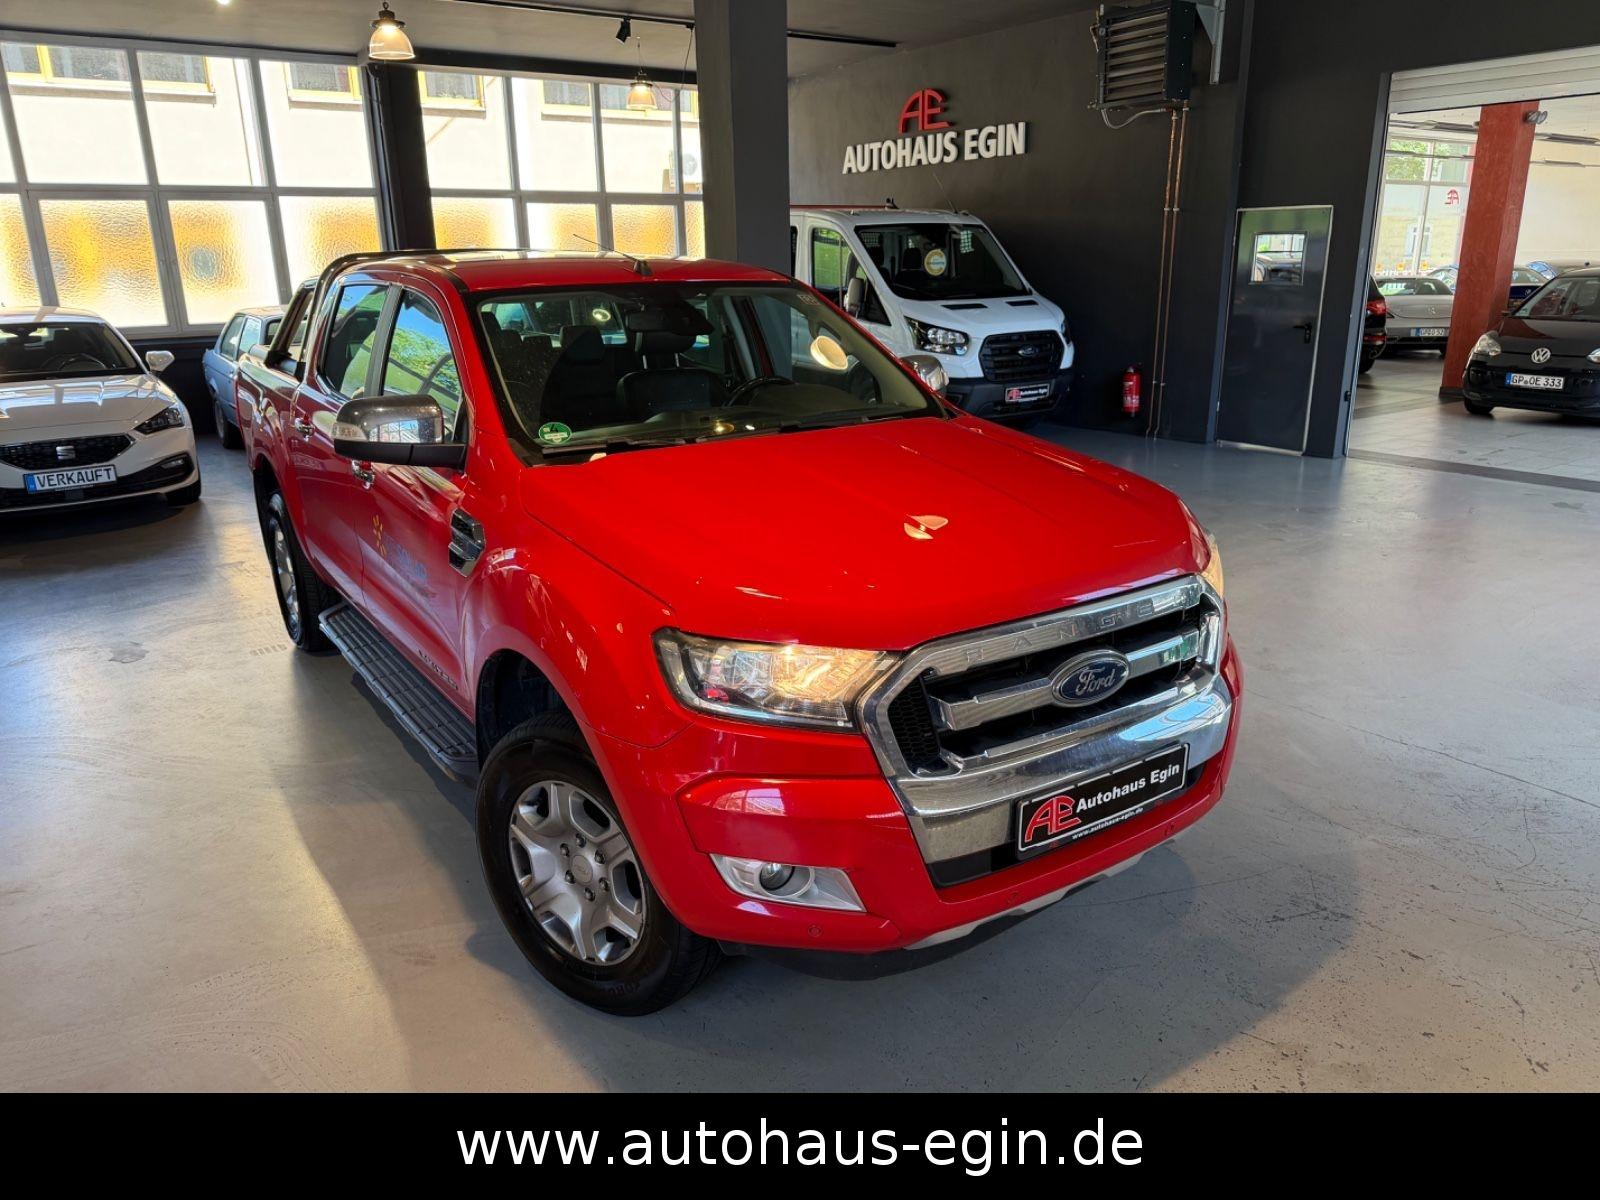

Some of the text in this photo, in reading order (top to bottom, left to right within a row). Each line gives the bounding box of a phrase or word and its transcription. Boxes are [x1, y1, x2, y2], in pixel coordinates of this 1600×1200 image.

[898, 88, 951, 133] AE
[842, 121, 1026, 175] AUTOHAUS EGIN
[36, 468, 113, 488] VERKAUFT
[1075, 667, 1116, 695] Ford
[1024, 763, 1180, 844] AE Autohaus Egin
